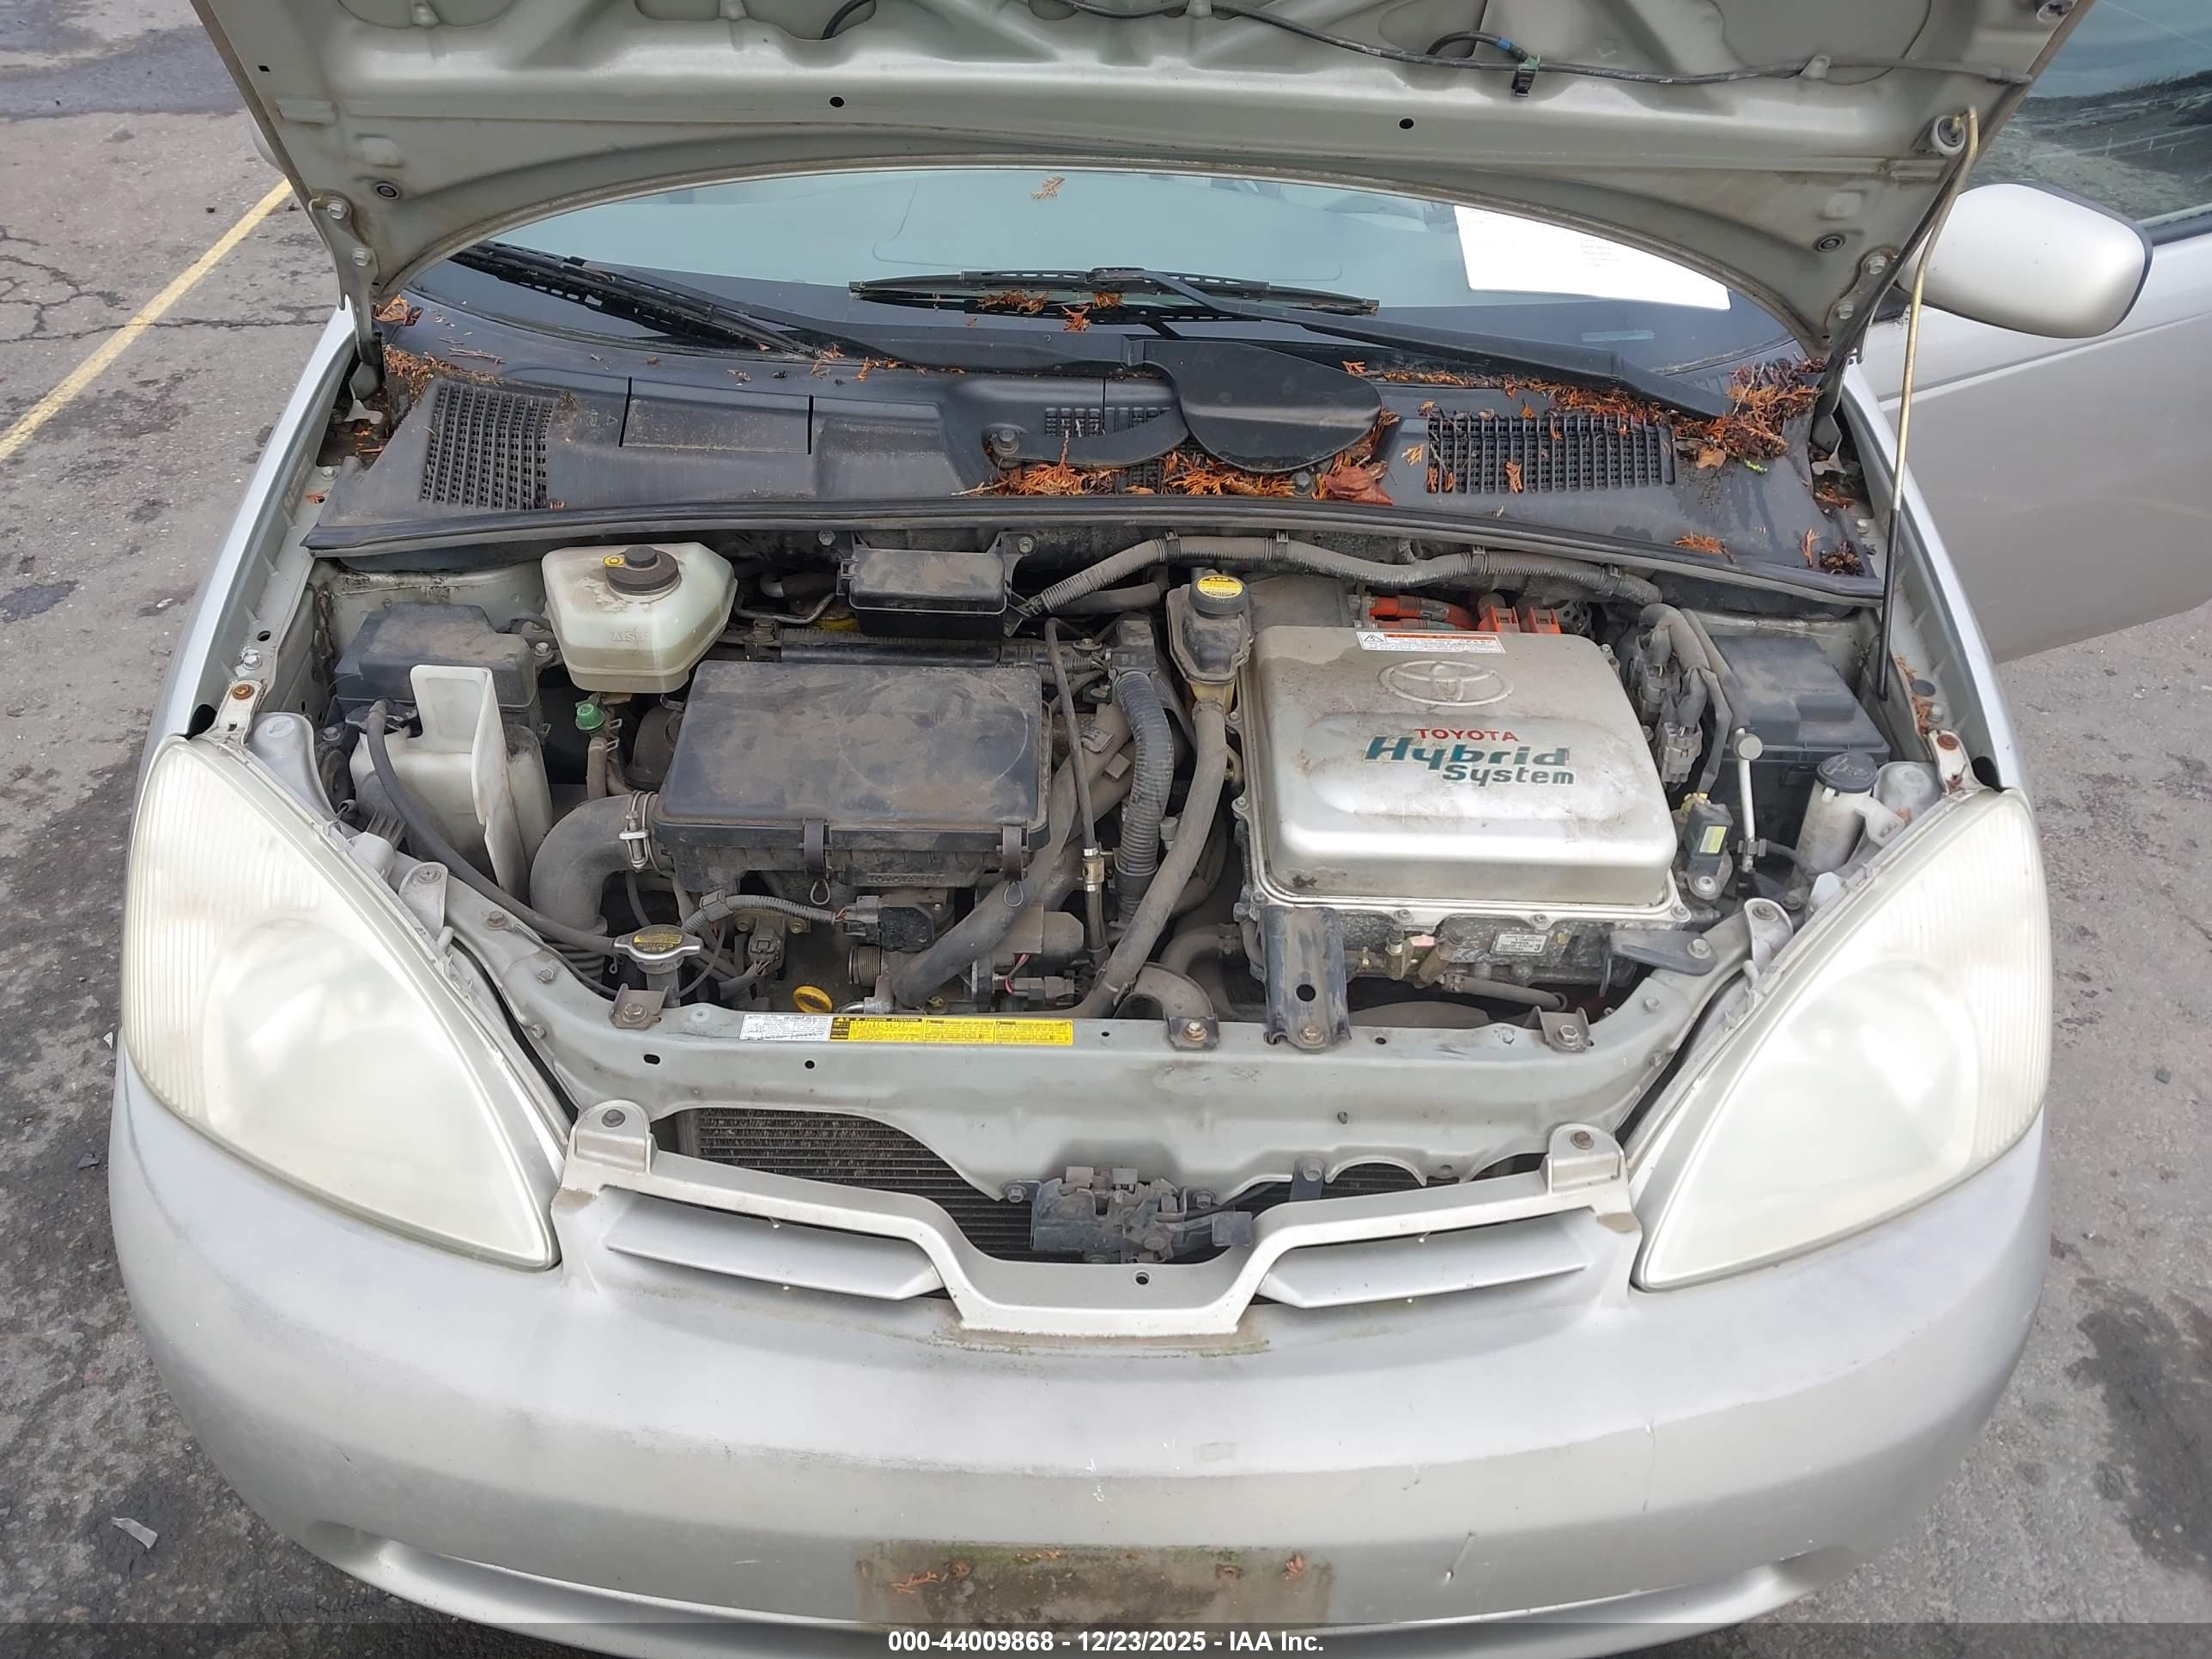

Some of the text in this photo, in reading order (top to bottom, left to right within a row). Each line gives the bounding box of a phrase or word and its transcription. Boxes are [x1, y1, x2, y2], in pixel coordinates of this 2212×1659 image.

[1415, 728, 1519, 742] TOYOTA
[1365, 736, 1570, 771] Hybrid
[1443, 764, 1574, 787] System
